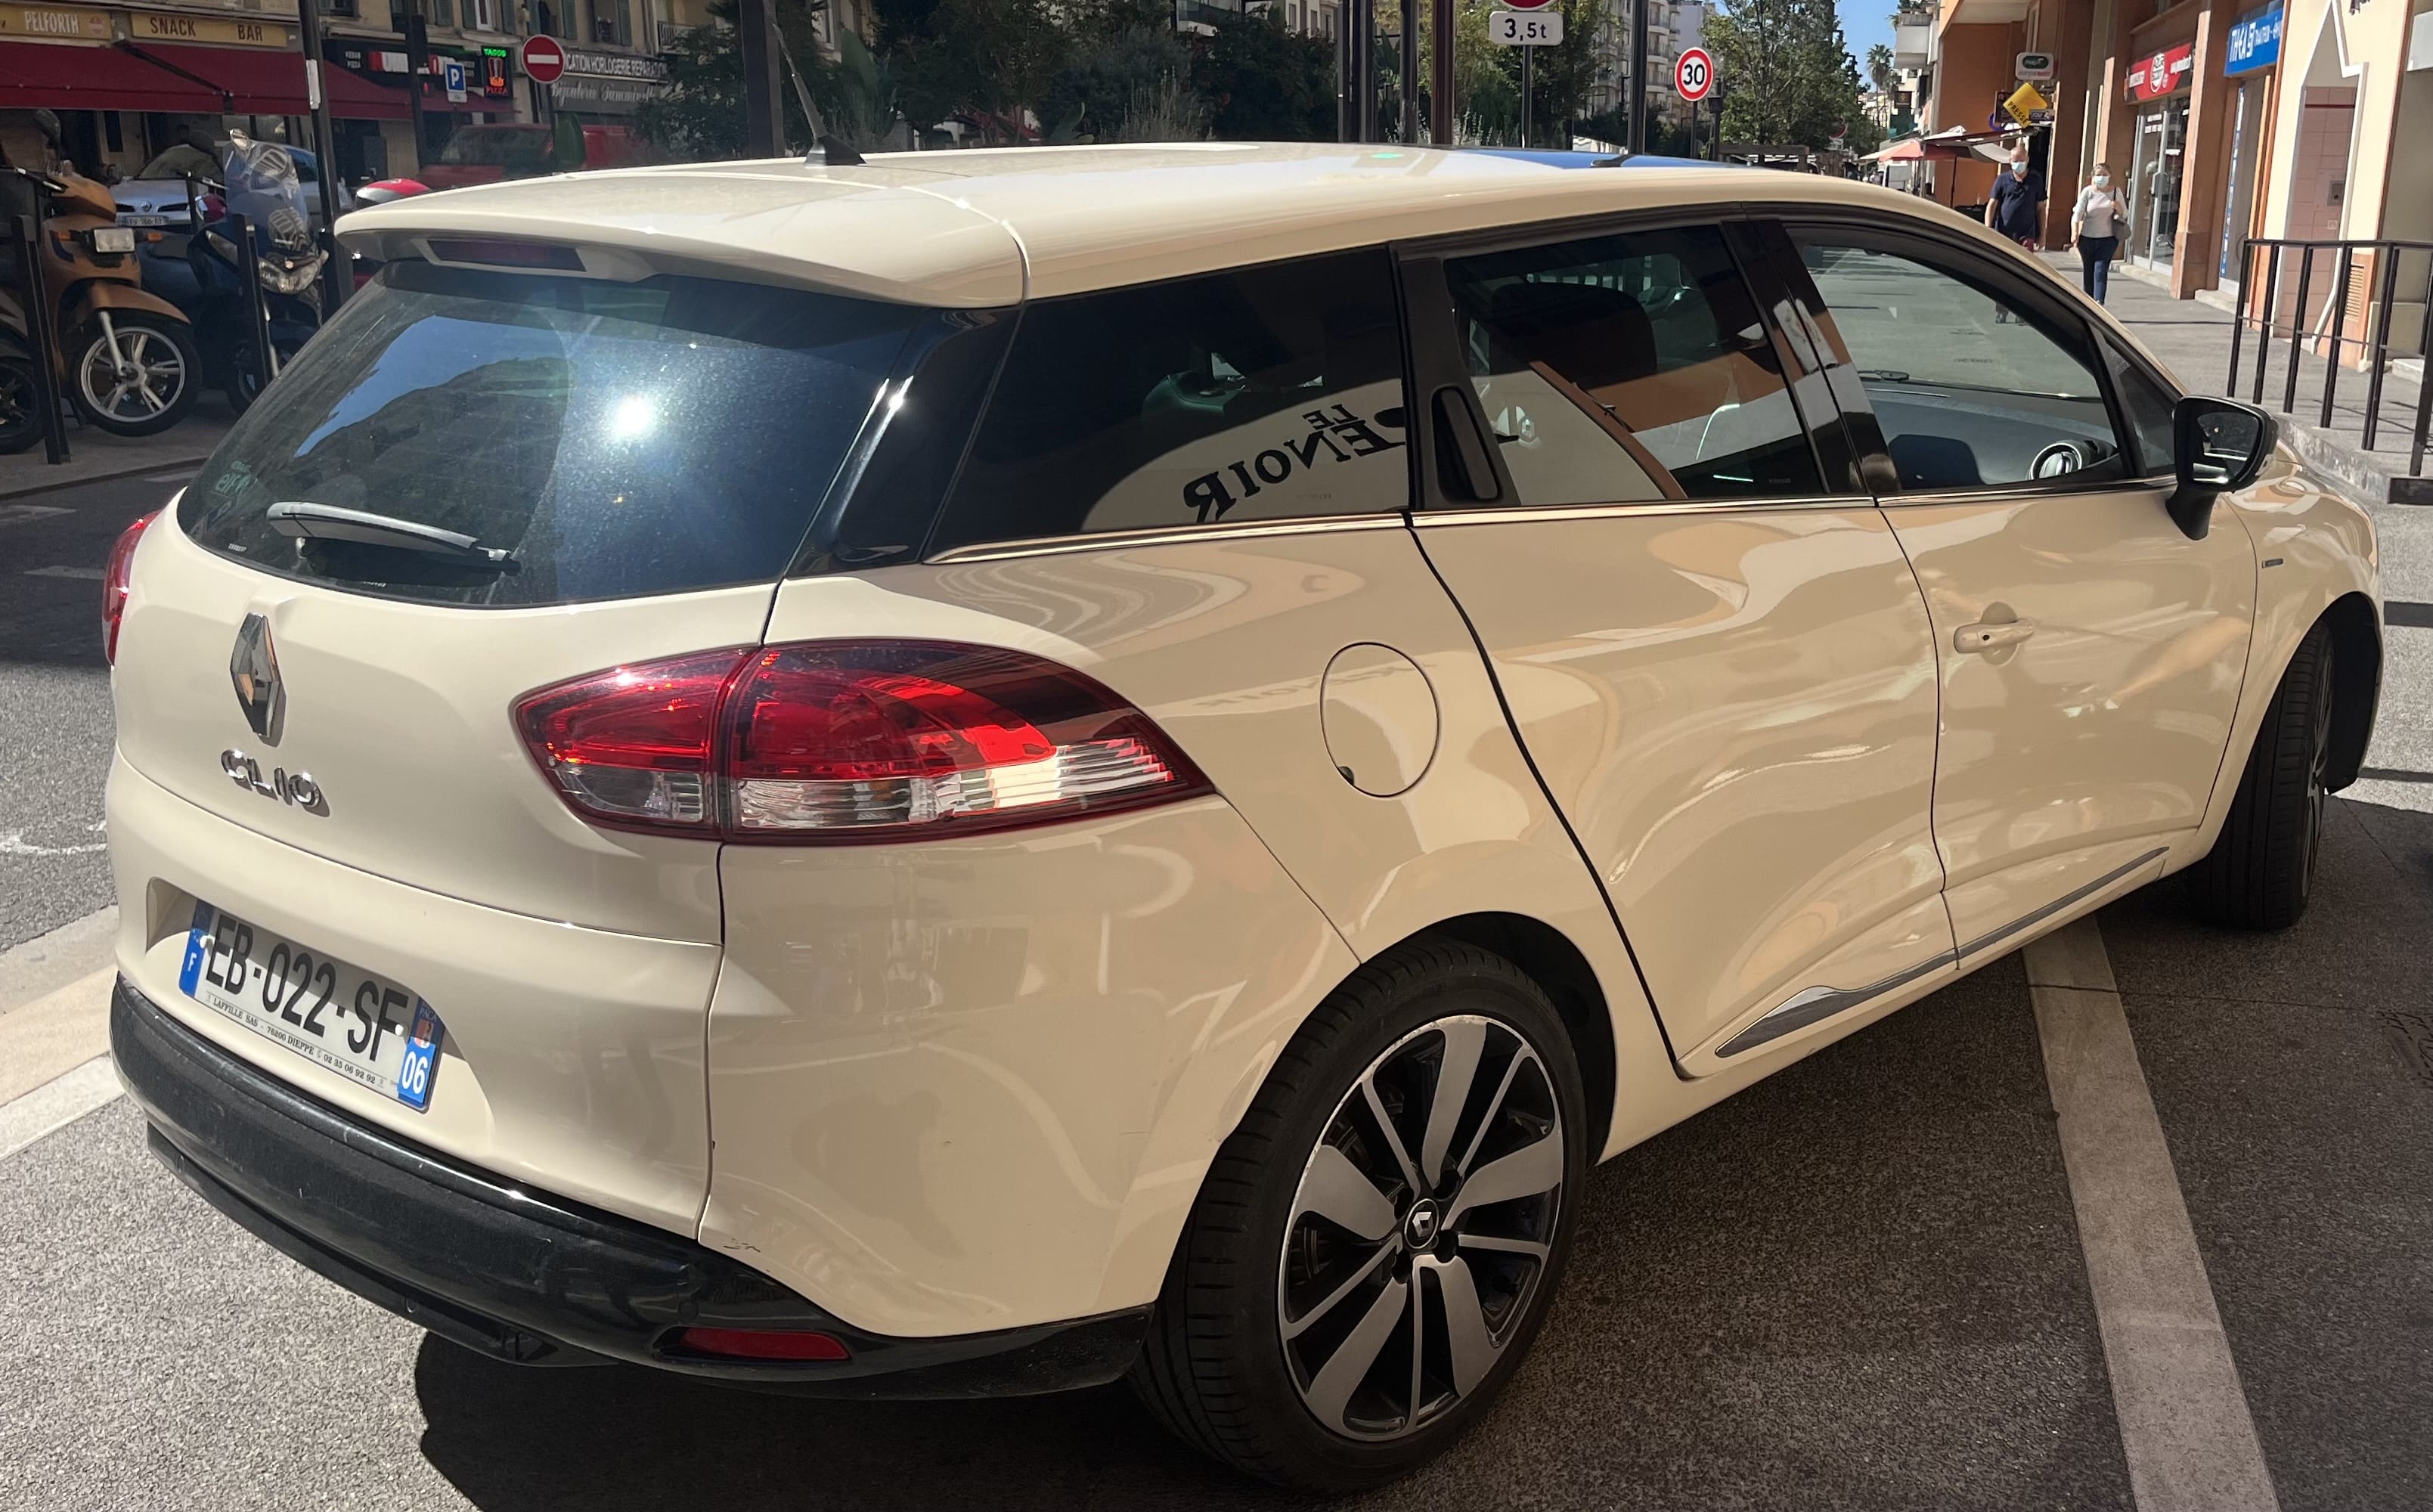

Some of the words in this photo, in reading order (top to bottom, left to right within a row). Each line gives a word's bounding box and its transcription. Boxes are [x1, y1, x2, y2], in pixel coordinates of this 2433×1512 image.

[24, 11, 79, 34] PELFORTH
[150, 17, 197, 37] SNACK
[237, 23, 263, 43] BAR
[451, 68, 460, 87] P
[1683, 64, 1706, 86] 30
[2007, 101, 2029, 125] PRESSE
[221, 748, 322, 807] CLIO
[187, 951, 198, 973] F
[205, 913, 409, 1063] EB-022-SF
[287, 1033, 315, 1055] DIEPPE
[324, 1054, 333, 1064] 02
[355, 1068, 364, 1080] 92
[366, 1074, 376, 1084] 92
[401, 1051, 428, 1095] 06
